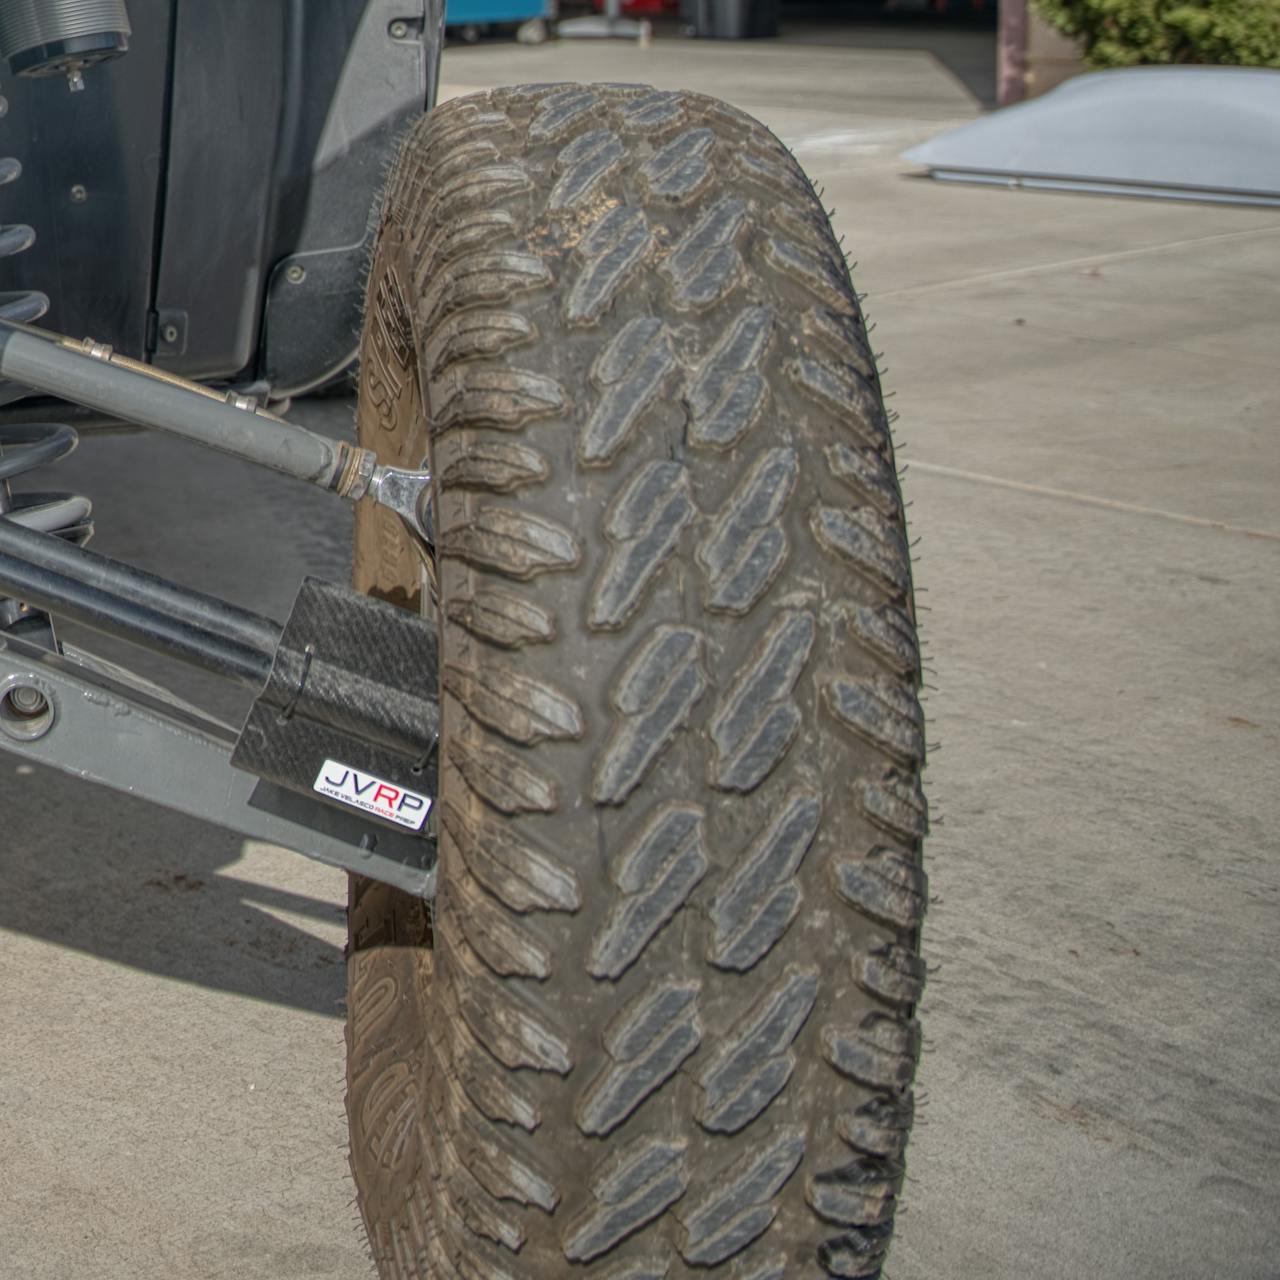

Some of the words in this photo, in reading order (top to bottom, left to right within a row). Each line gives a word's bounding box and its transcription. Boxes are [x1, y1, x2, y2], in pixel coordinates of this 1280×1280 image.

[320, 786, 340, 797] JAKE
[340, 793, 374, 810] VELASCO
[374, 806, 395, 818] RACE
[324, 770, 424, 811] JVRP
